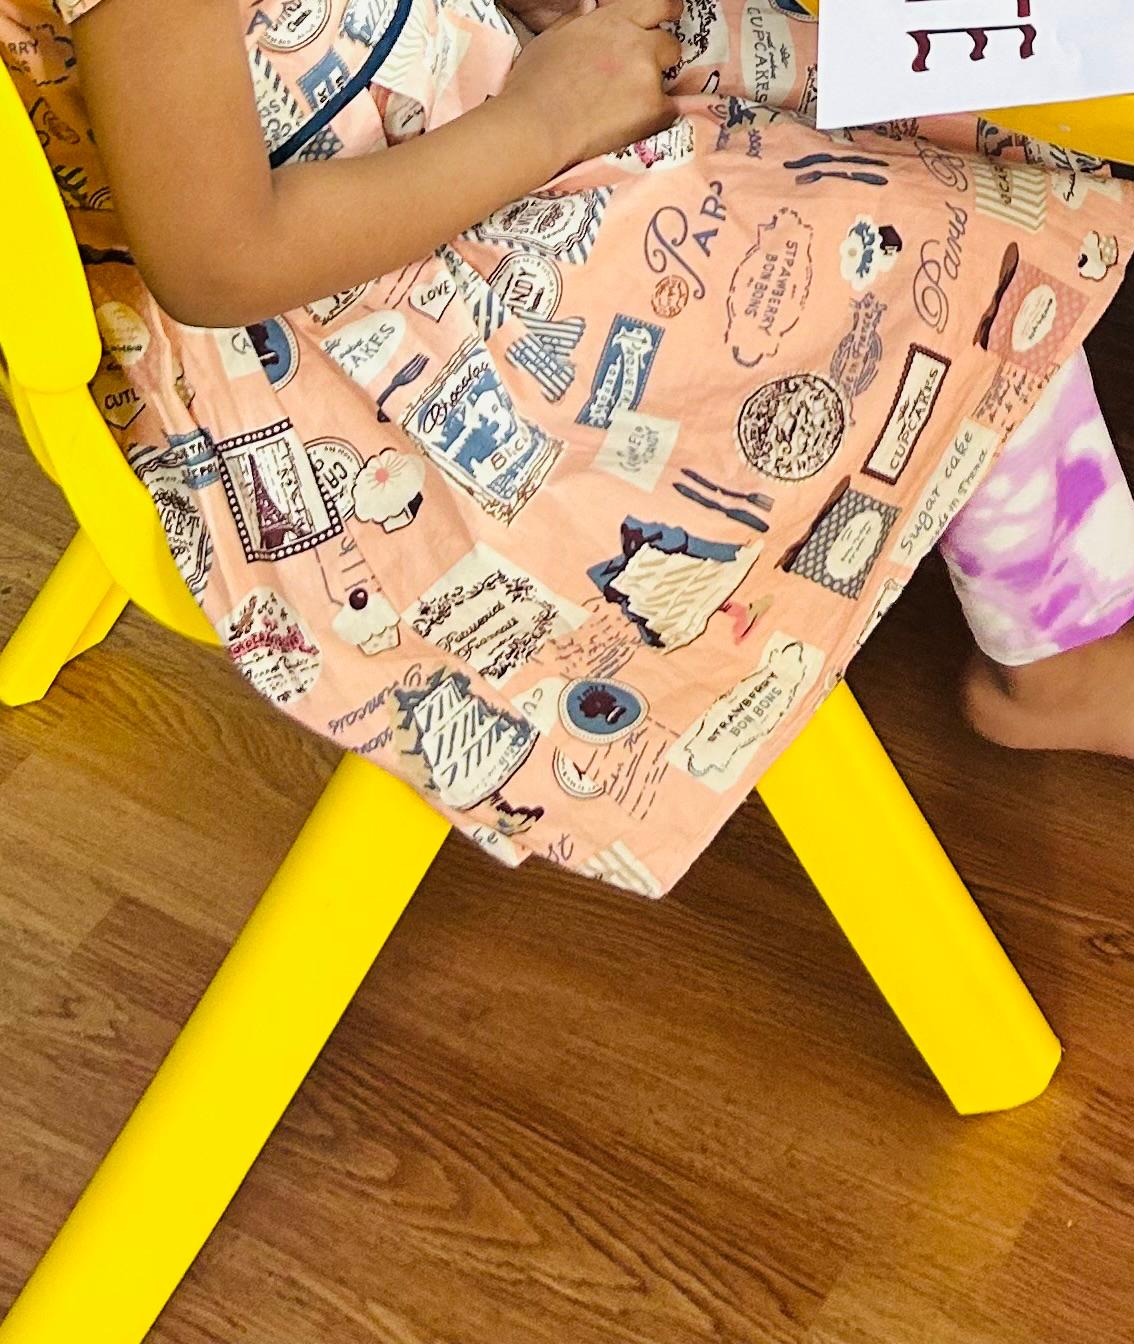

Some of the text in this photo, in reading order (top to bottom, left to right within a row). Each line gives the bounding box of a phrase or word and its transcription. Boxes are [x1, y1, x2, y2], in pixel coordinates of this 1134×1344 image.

[420, 279, 451, 306] LOVE
[757, 239, 799, 337] STRAWBERRY
[889, 367, 939, 470] CUPCAKES
